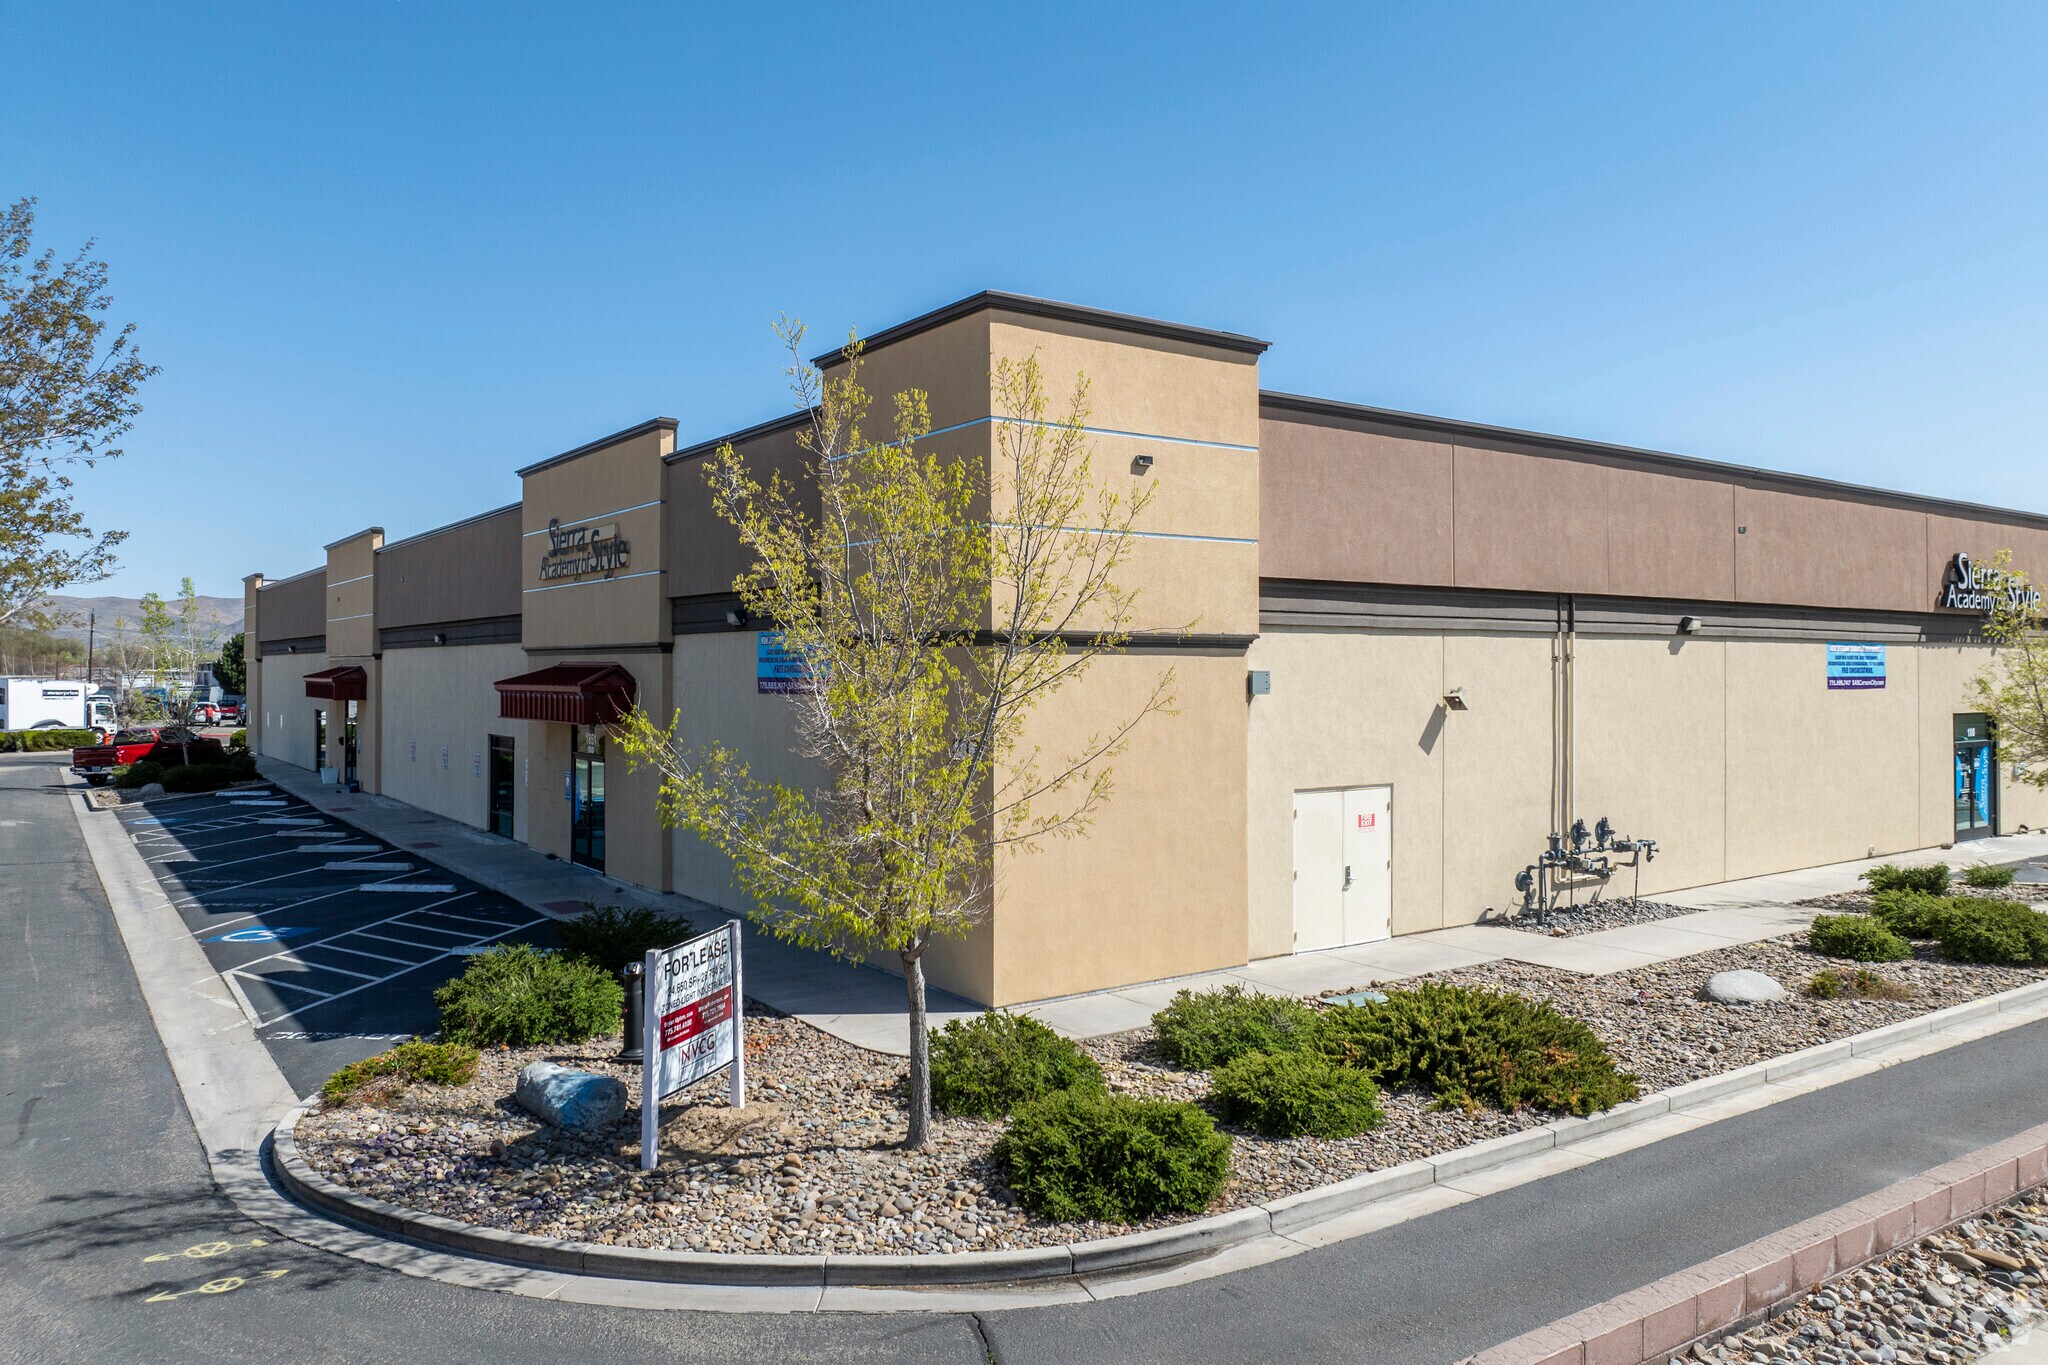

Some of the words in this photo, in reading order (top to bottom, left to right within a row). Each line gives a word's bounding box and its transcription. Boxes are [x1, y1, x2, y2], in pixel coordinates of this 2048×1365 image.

[539, 555, 582, 581] Academy
[581, 552, 591, 573] of
[590, 529, 627, 579] Style
[549, 518, 586, 557] Sierra
[1955, 552, 2001, 590] Sierra
[1946, 584, 1995, 615] Academy
[2005, 576, 2041, 616] Style
[1967, 727, 1975, 737] 100
[664, 954, 690, 981] FOR
[691, 938, 728, 969] LEASE
[681, 1033, 715, 1065] NVCG
